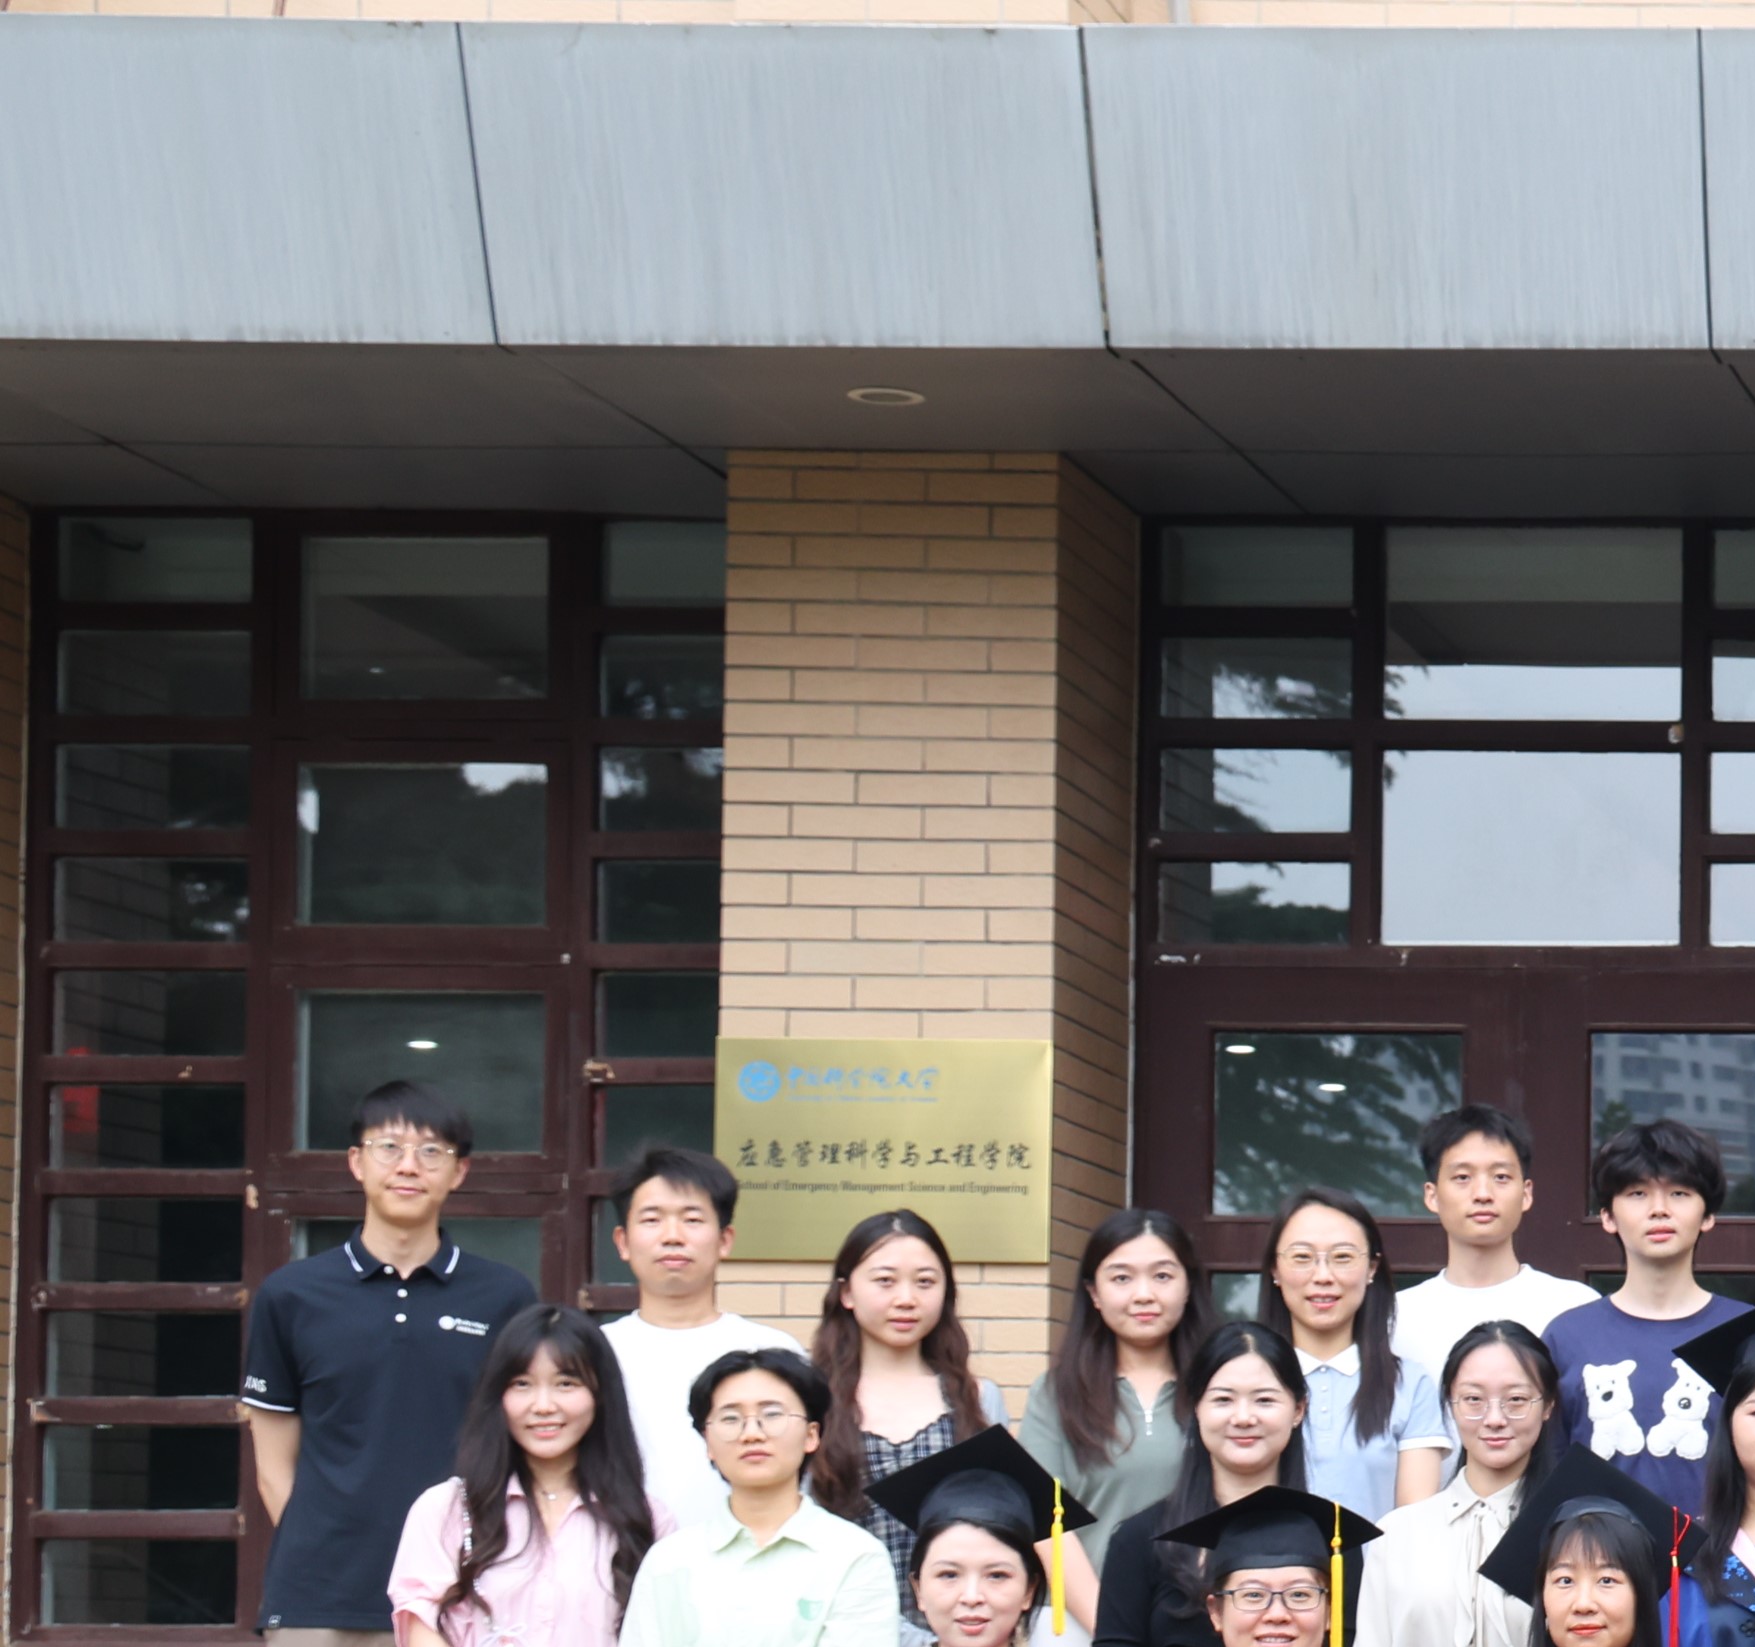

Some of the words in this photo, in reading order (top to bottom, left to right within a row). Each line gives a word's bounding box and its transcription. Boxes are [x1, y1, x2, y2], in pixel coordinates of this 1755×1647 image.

[736, 1138, 1032, 1170] 应急管理科学与工程学院
